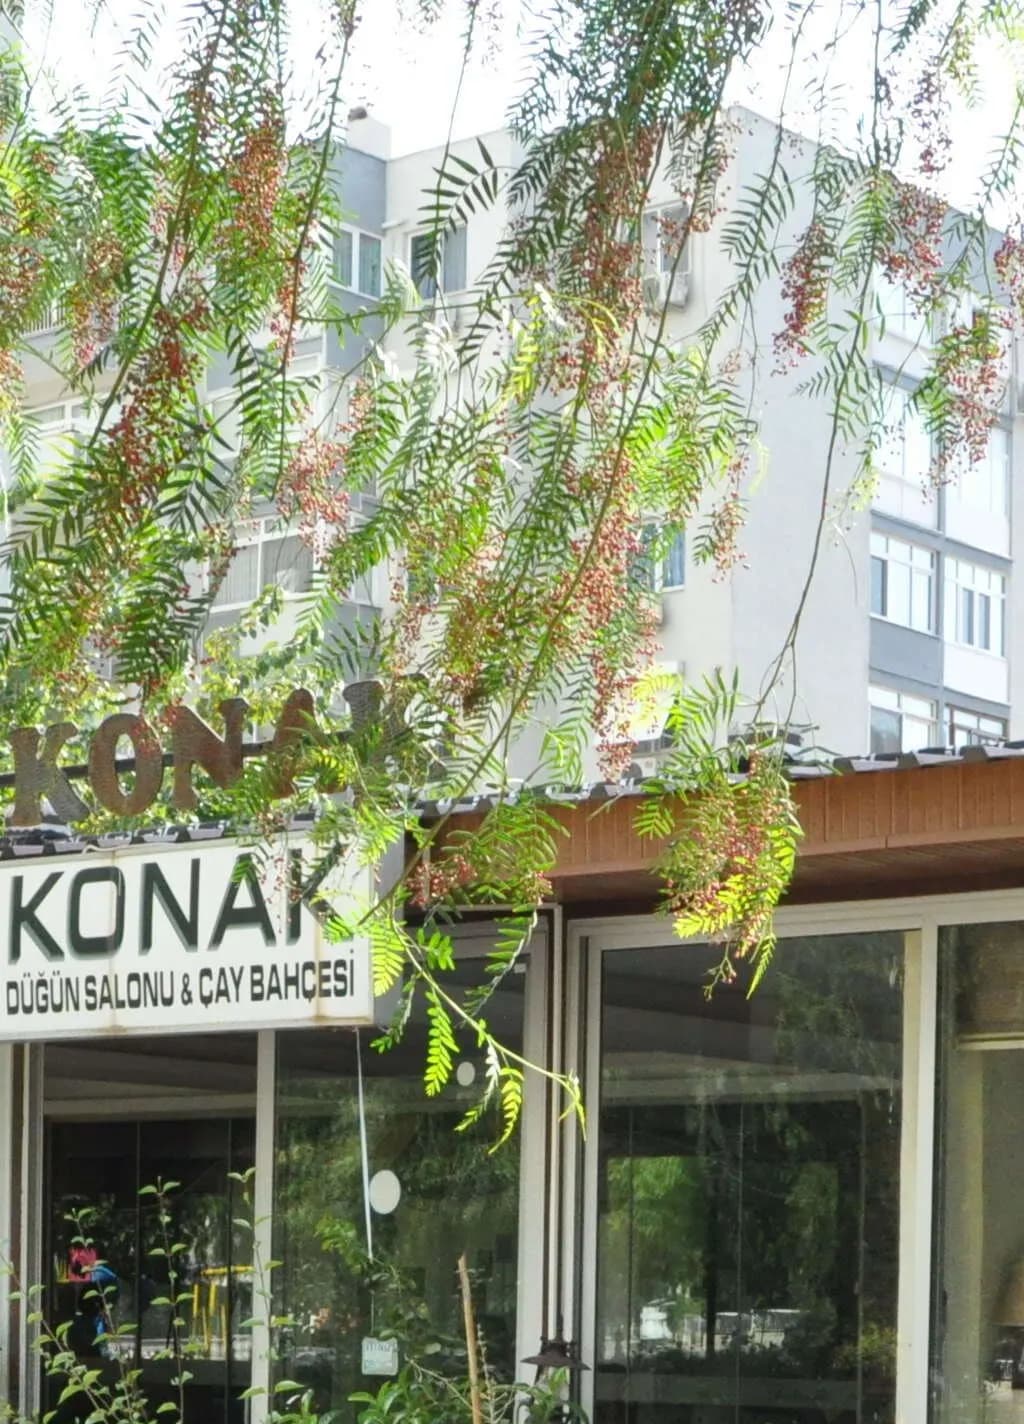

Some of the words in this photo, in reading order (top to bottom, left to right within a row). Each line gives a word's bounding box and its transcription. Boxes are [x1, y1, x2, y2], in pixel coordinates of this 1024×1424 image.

[9, 842, 355, 965] KONAK
[6, 970, 80, 1015] DÜĞÜN
[84, 971, 175, 1011] SALONU
[181, 973, 193, 1006] &
[200, 965, 244, 1009] ÇAY
[250, 949, 354, 1003] BAHÇESİ
